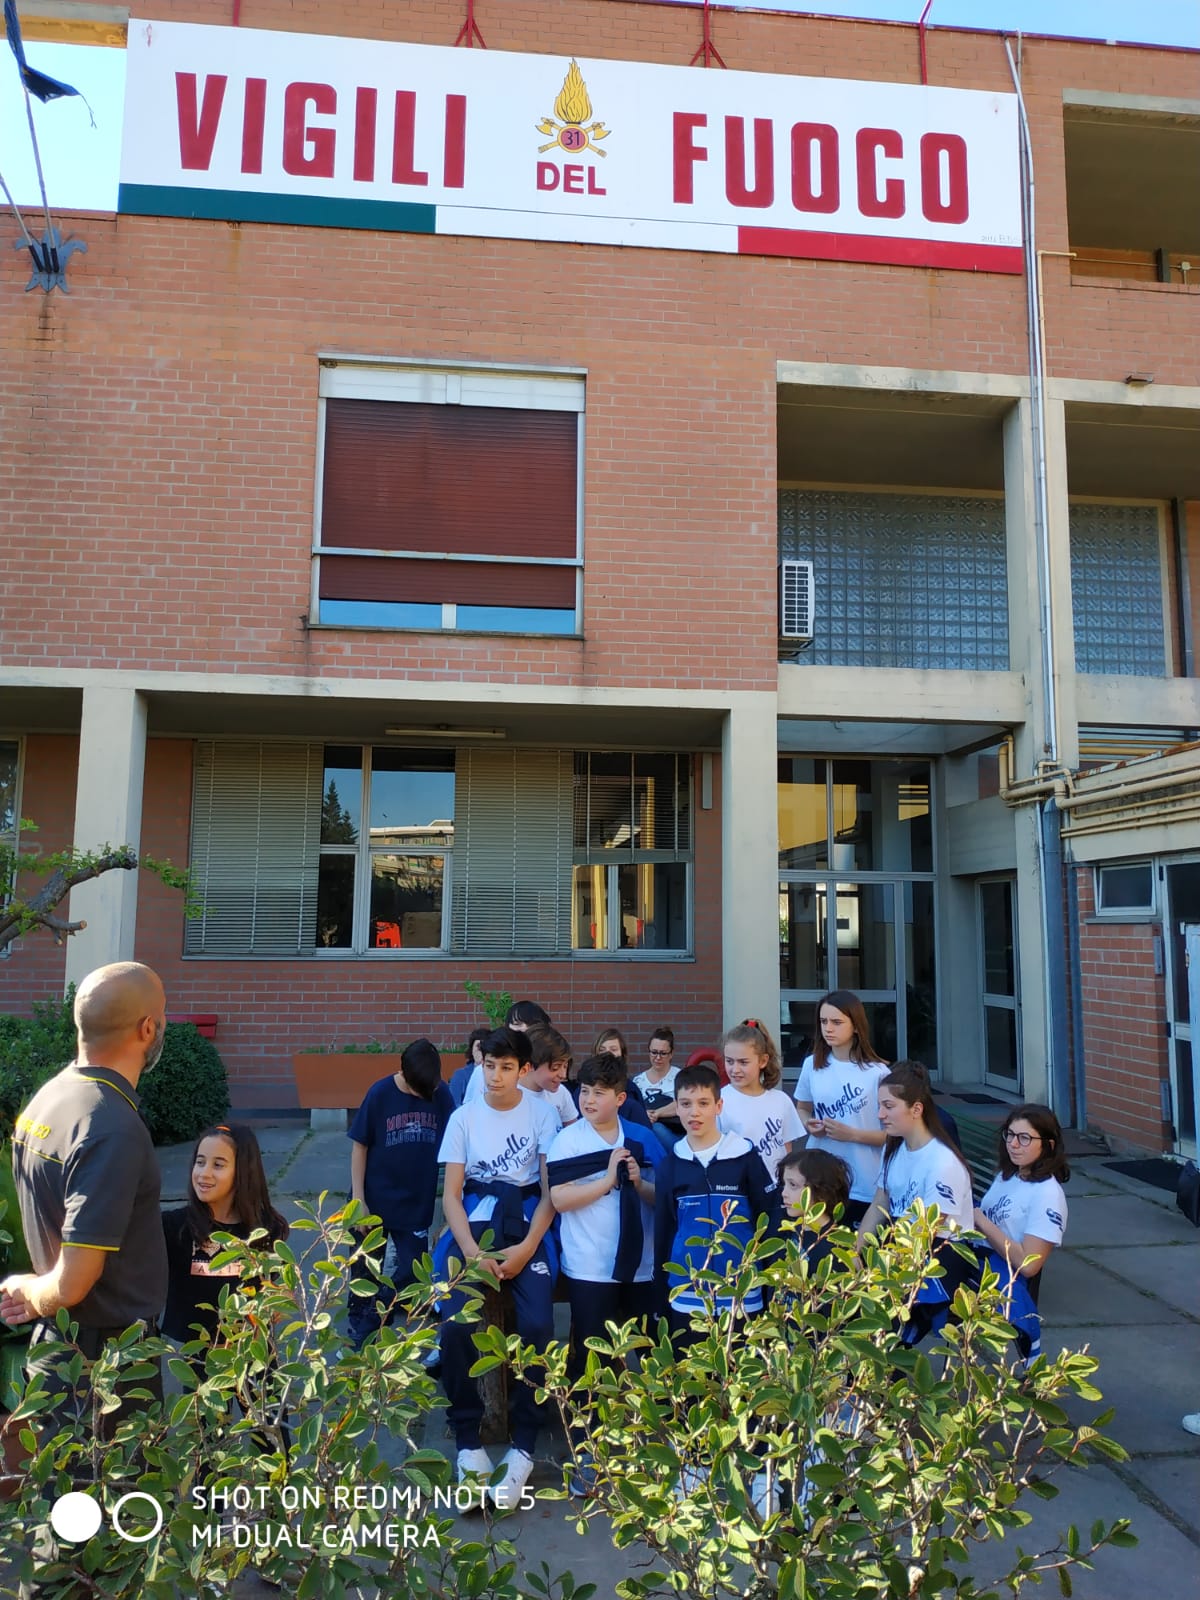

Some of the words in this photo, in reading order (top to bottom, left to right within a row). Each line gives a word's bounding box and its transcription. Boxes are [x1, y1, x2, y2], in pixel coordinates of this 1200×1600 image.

[175, 72, 467, 188] VIGILI
[536, 161, 606, 196] DEL
[672, 111, 969, 225] FUOCO
[565, 131, 580, 146] 31
[815, 1083, 864, 1120] Mugello
